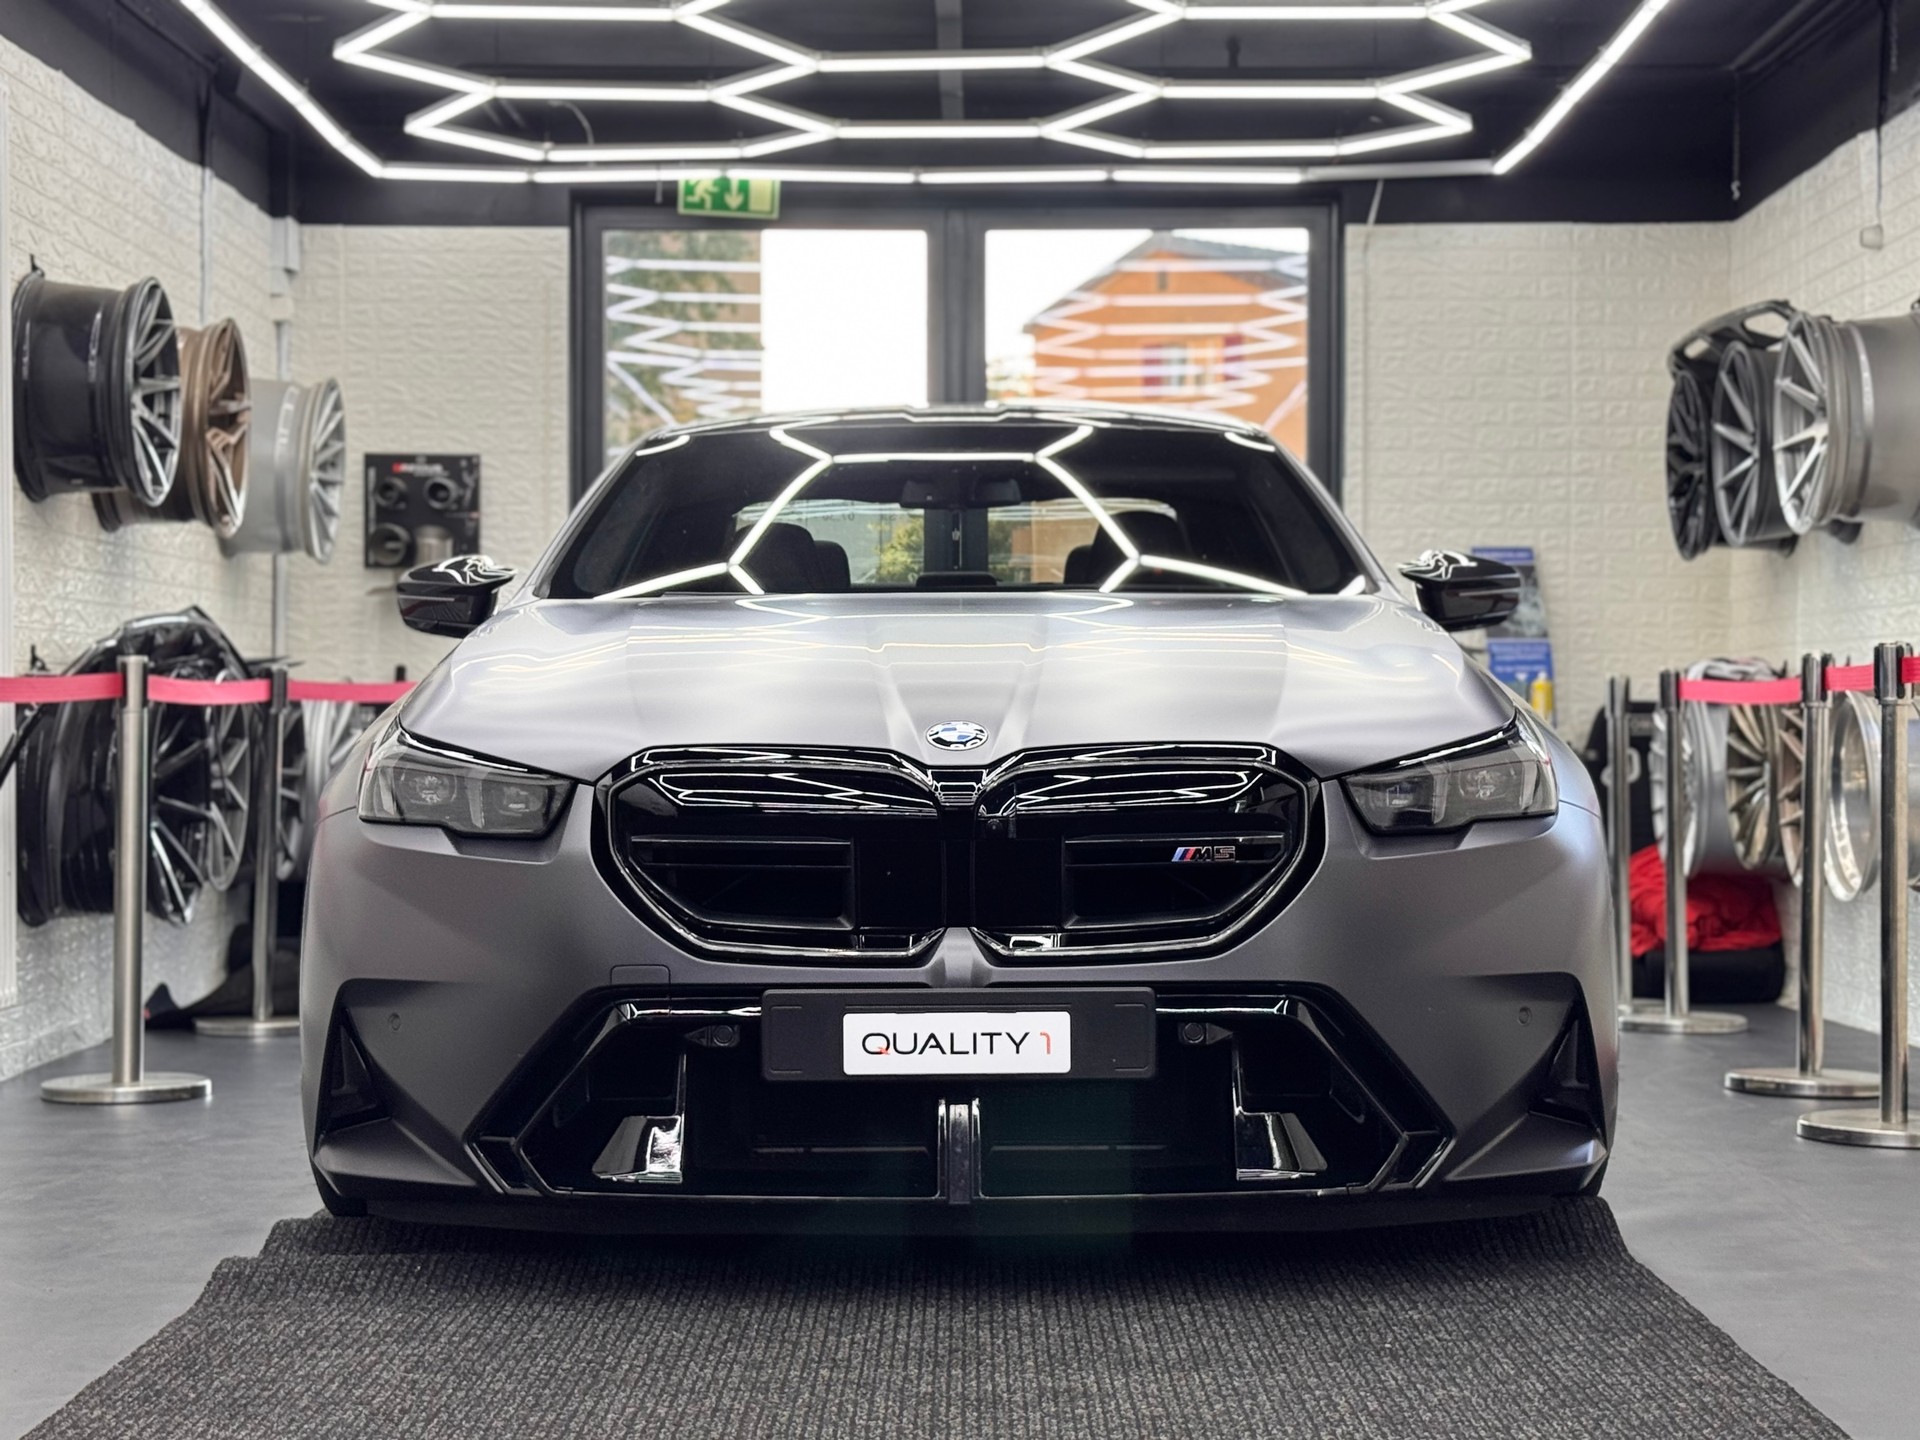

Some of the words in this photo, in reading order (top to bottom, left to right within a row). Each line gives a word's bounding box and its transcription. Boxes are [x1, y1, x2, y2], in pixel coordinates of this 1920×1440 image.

[1180, 846, 1236, 862] M5
[861, 1031, 1031, 1055] QUALITY
[1039, 1031, 1051, 1055] 1
